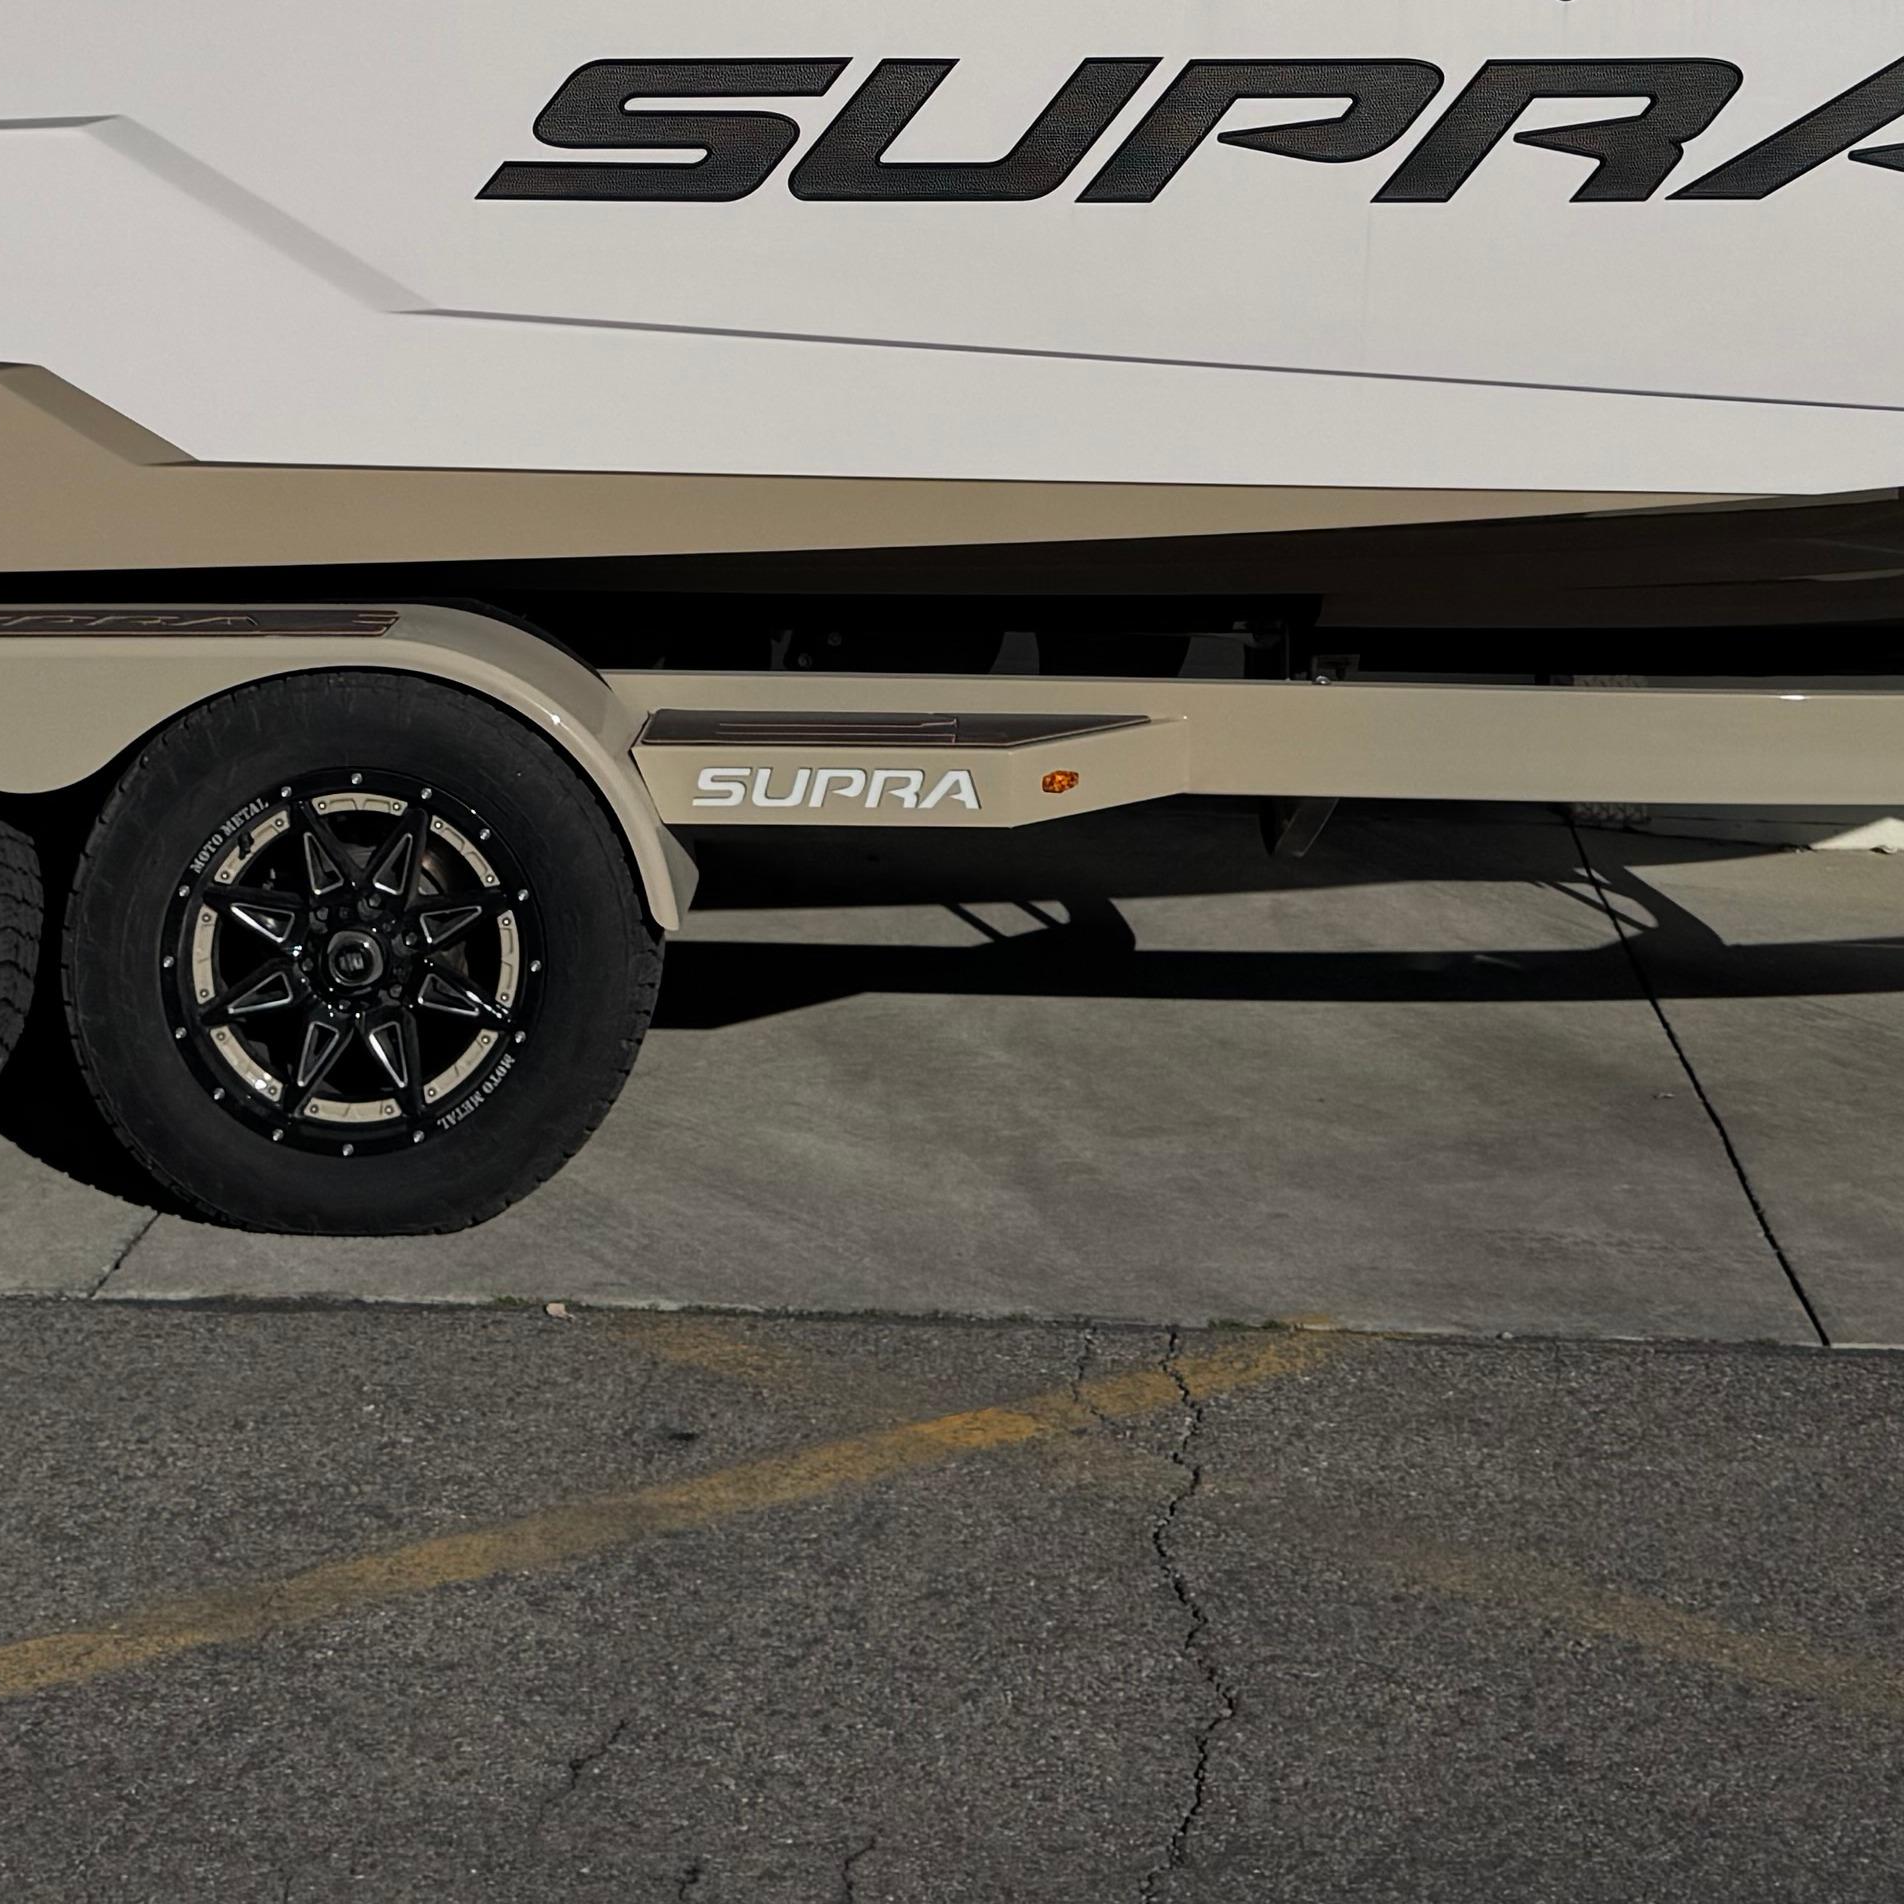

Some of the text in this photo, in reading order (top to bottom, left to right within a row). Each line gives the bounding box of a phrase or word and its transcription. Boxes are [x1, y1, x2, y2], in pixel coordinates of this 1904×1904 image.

[692, 767, 982, 810] SUPRA
[190, 798, 269, 874] MOTO METAL
[437, 1053, 516, 1130] MOTO METAL
